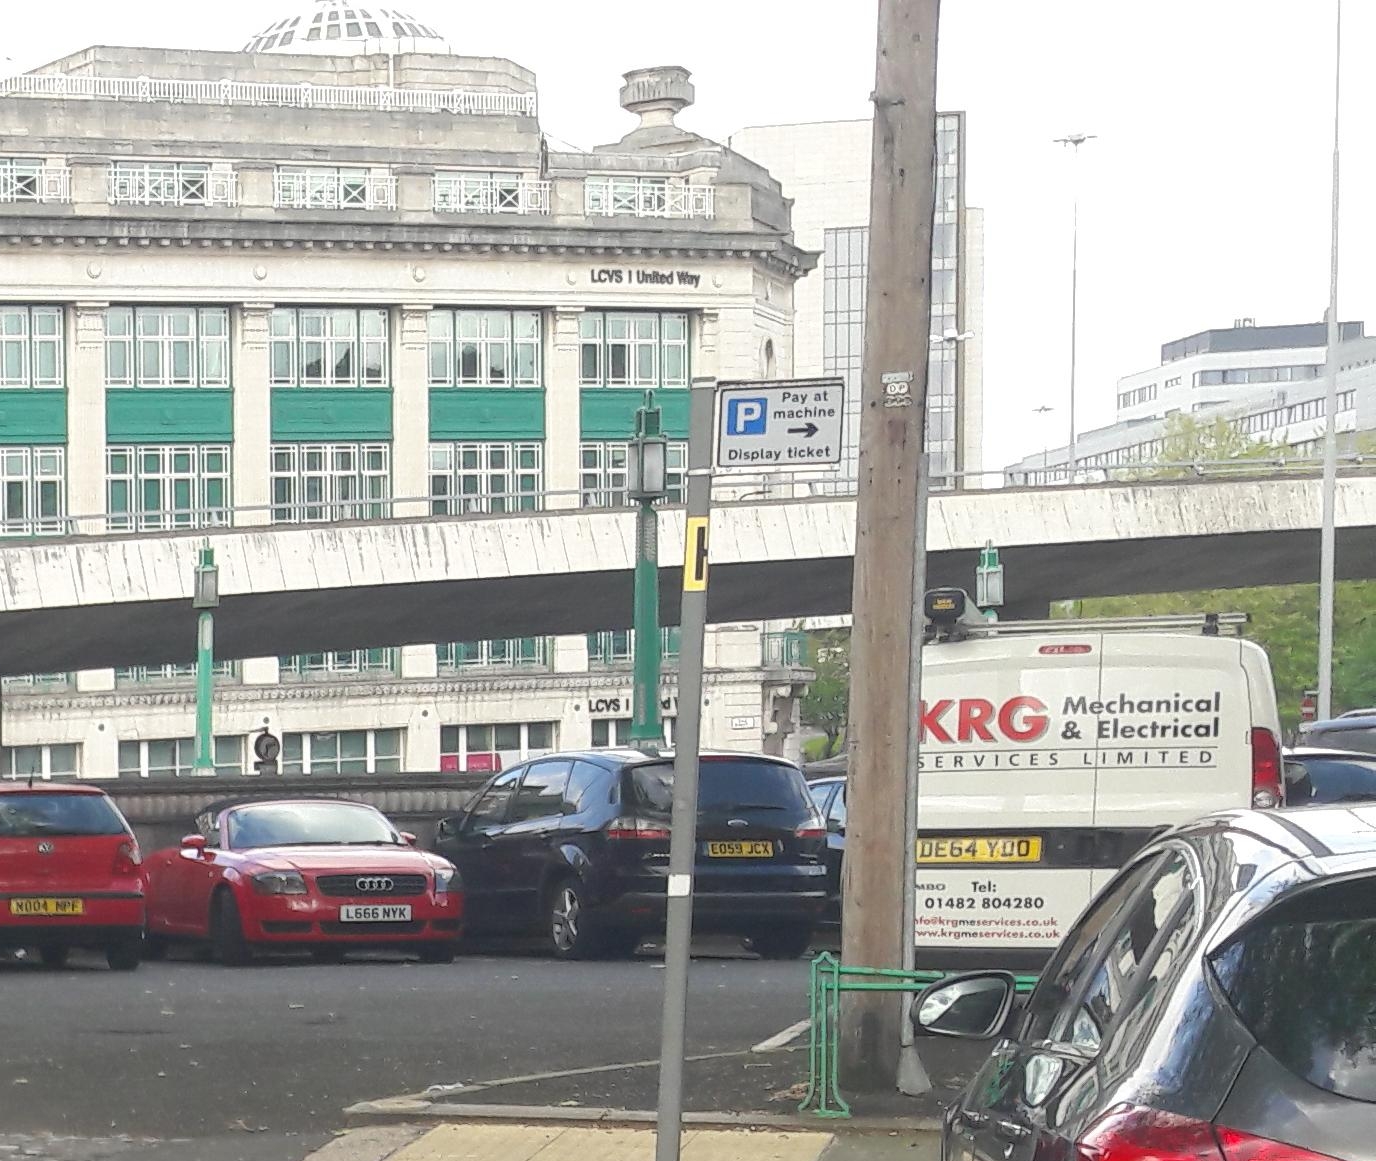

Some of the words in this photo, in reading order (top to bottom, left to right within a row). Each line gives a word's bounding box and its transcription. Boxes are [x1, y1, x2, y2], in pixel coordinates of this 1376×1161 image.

[590, 269, 623, 283] LCVS
[636, 270, 673, 285] United
[676, 271, 701, 288] Way
[782, 392, 808, 404] Pay
[814, 391, 829, 402] at
[735, 402, 762, 433] P
[773, 407, 836, 420] machine
[728, 449, 781, 461] Display
[787, 446, 831, 459] ticket
[588, 698, 621, 713] LCVS
[920, 695, 1051, 745] KRG
[1062, 692, 1220, 716] Mechanical
[1061, 720, 1082, 741] &
[1098, 717, 1220, 740] Electrical
[918, 752, 1060, 769] SERVICES
[1083, 751, 1213, 766] LIMITED
[919, 840, 978, 858] DE64
[971, 881, 997, 893] Tel:
[925, 897, 976, 909] 01482
[981, 897, 1045, 909] 804280
[346, 907, 380, 919] L666
[382, 907, 407, 919] NYK
[914, 916, 1058, 927] nfo@krgmeservices.co.uk
